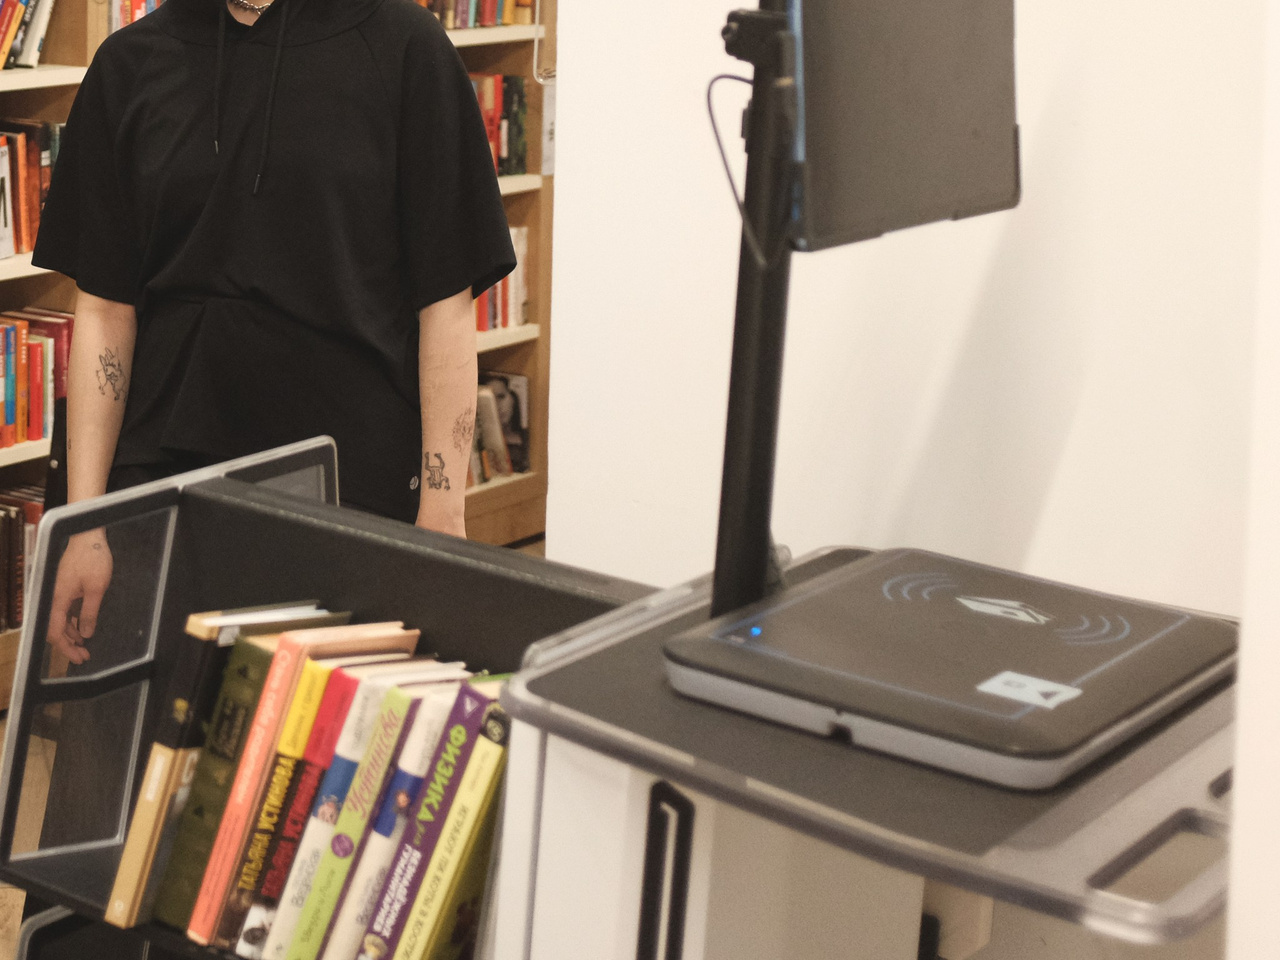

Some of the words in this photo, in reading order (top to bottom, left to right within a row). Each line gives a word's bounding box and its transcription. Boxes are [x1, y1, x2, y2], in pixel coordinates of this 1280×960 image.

[238, 829, 272, 892] ТАТЬЯНА
[263, 754, 297, 832] УСТИНОВА
[418, 724, 467, 824] ФИЗИКА
